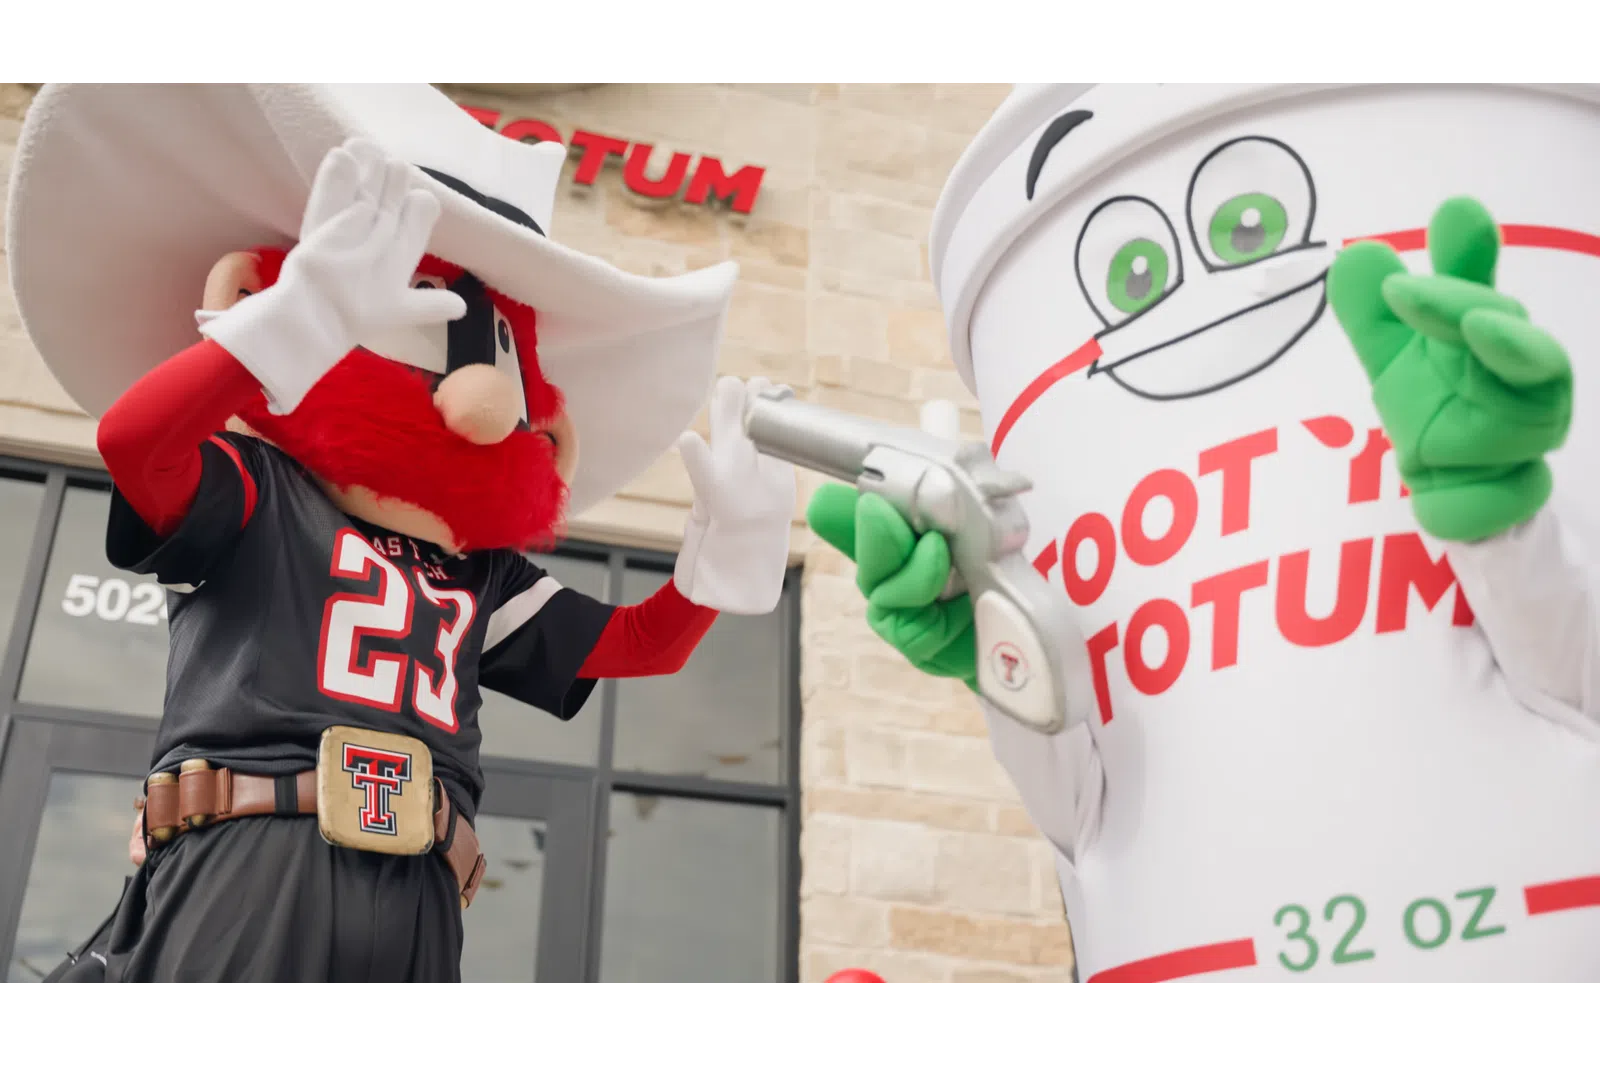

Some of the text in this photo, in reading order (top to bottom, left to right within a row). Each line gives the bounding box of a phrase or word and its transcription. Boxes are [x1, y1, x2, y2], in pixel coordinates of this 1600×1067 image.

[458, 104, 766, 214] TUM
[61, 574, 169, 626] 502
[317, 527, 477, 734] 23
[1273, 884, 1506, 973] 32 oz
